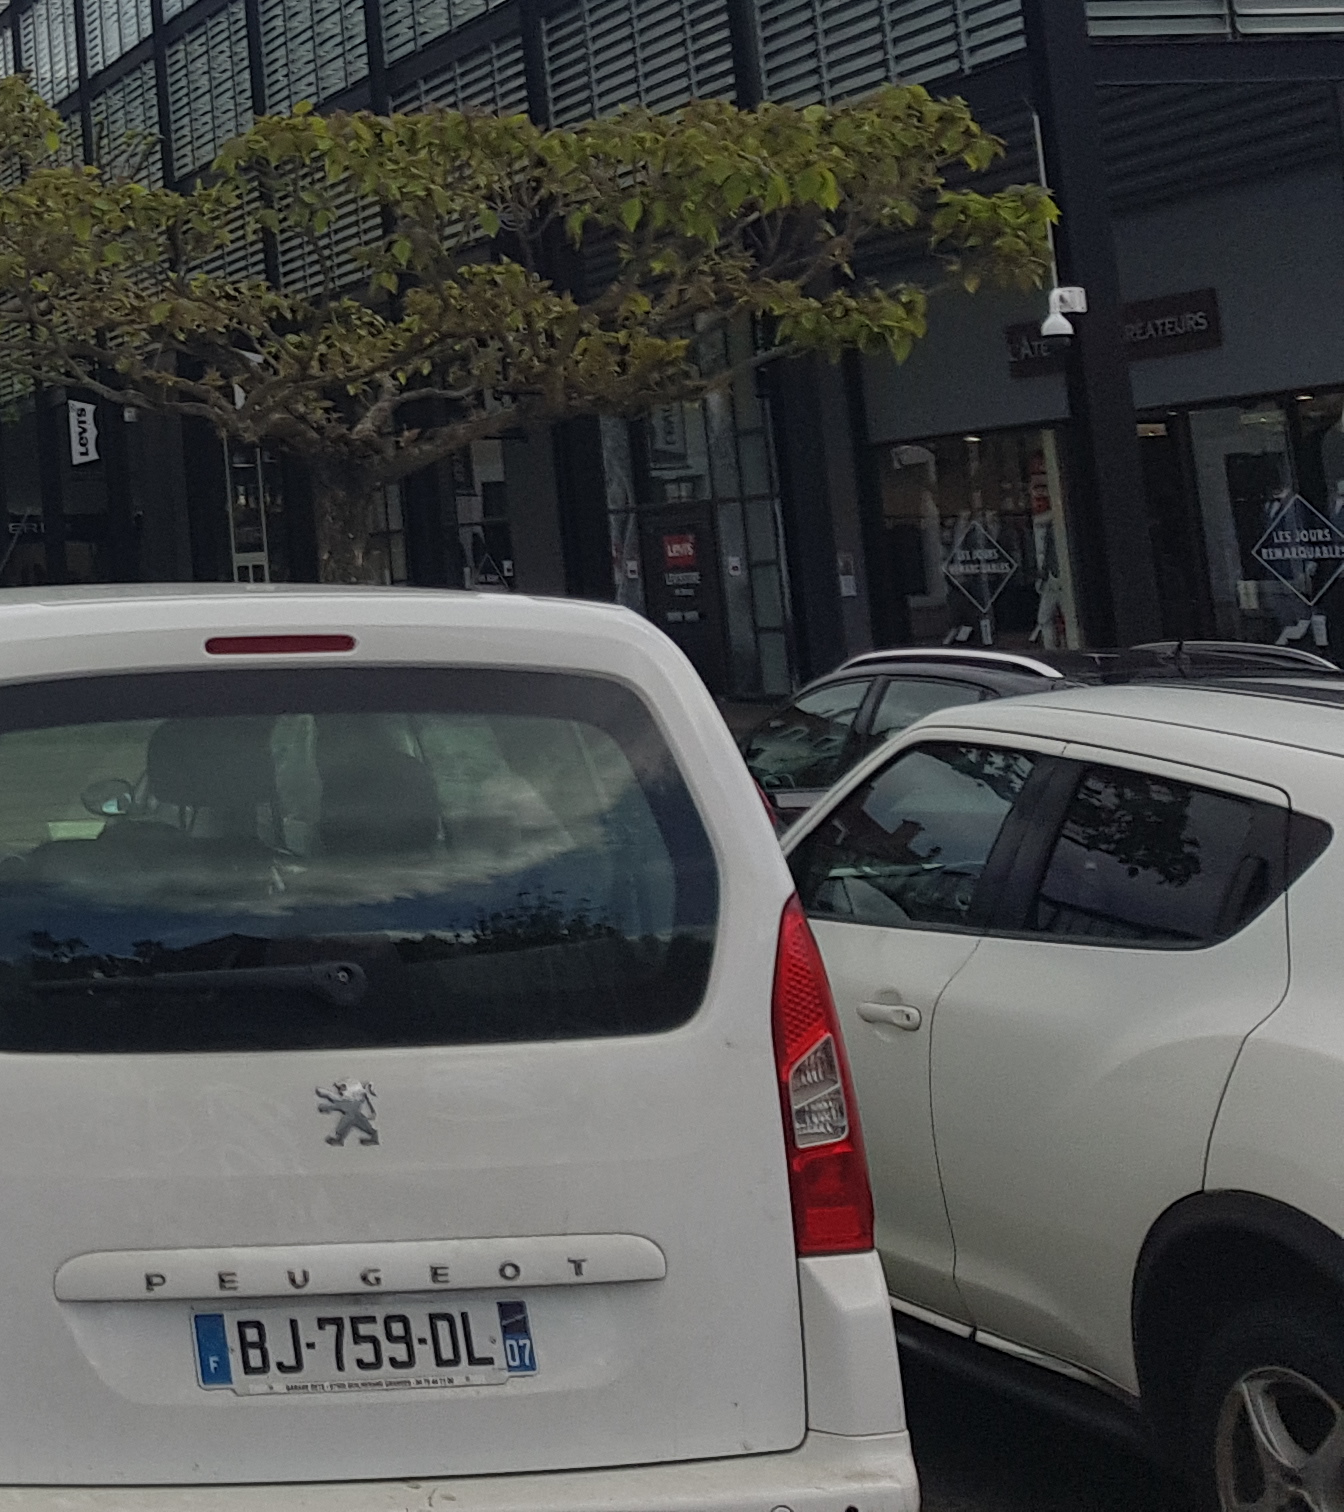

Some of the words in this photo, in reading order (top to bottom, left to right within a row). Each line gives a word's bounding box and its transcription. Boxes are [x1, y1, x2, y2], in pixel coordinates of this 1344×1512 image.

[145, 1257, 588, 1292] PEUGEOT
[209, 1356, 219, 1374] F
[237, 1311, 494, 1376] BJ-759-DL
[507, 1338, 531, 1368] 07
